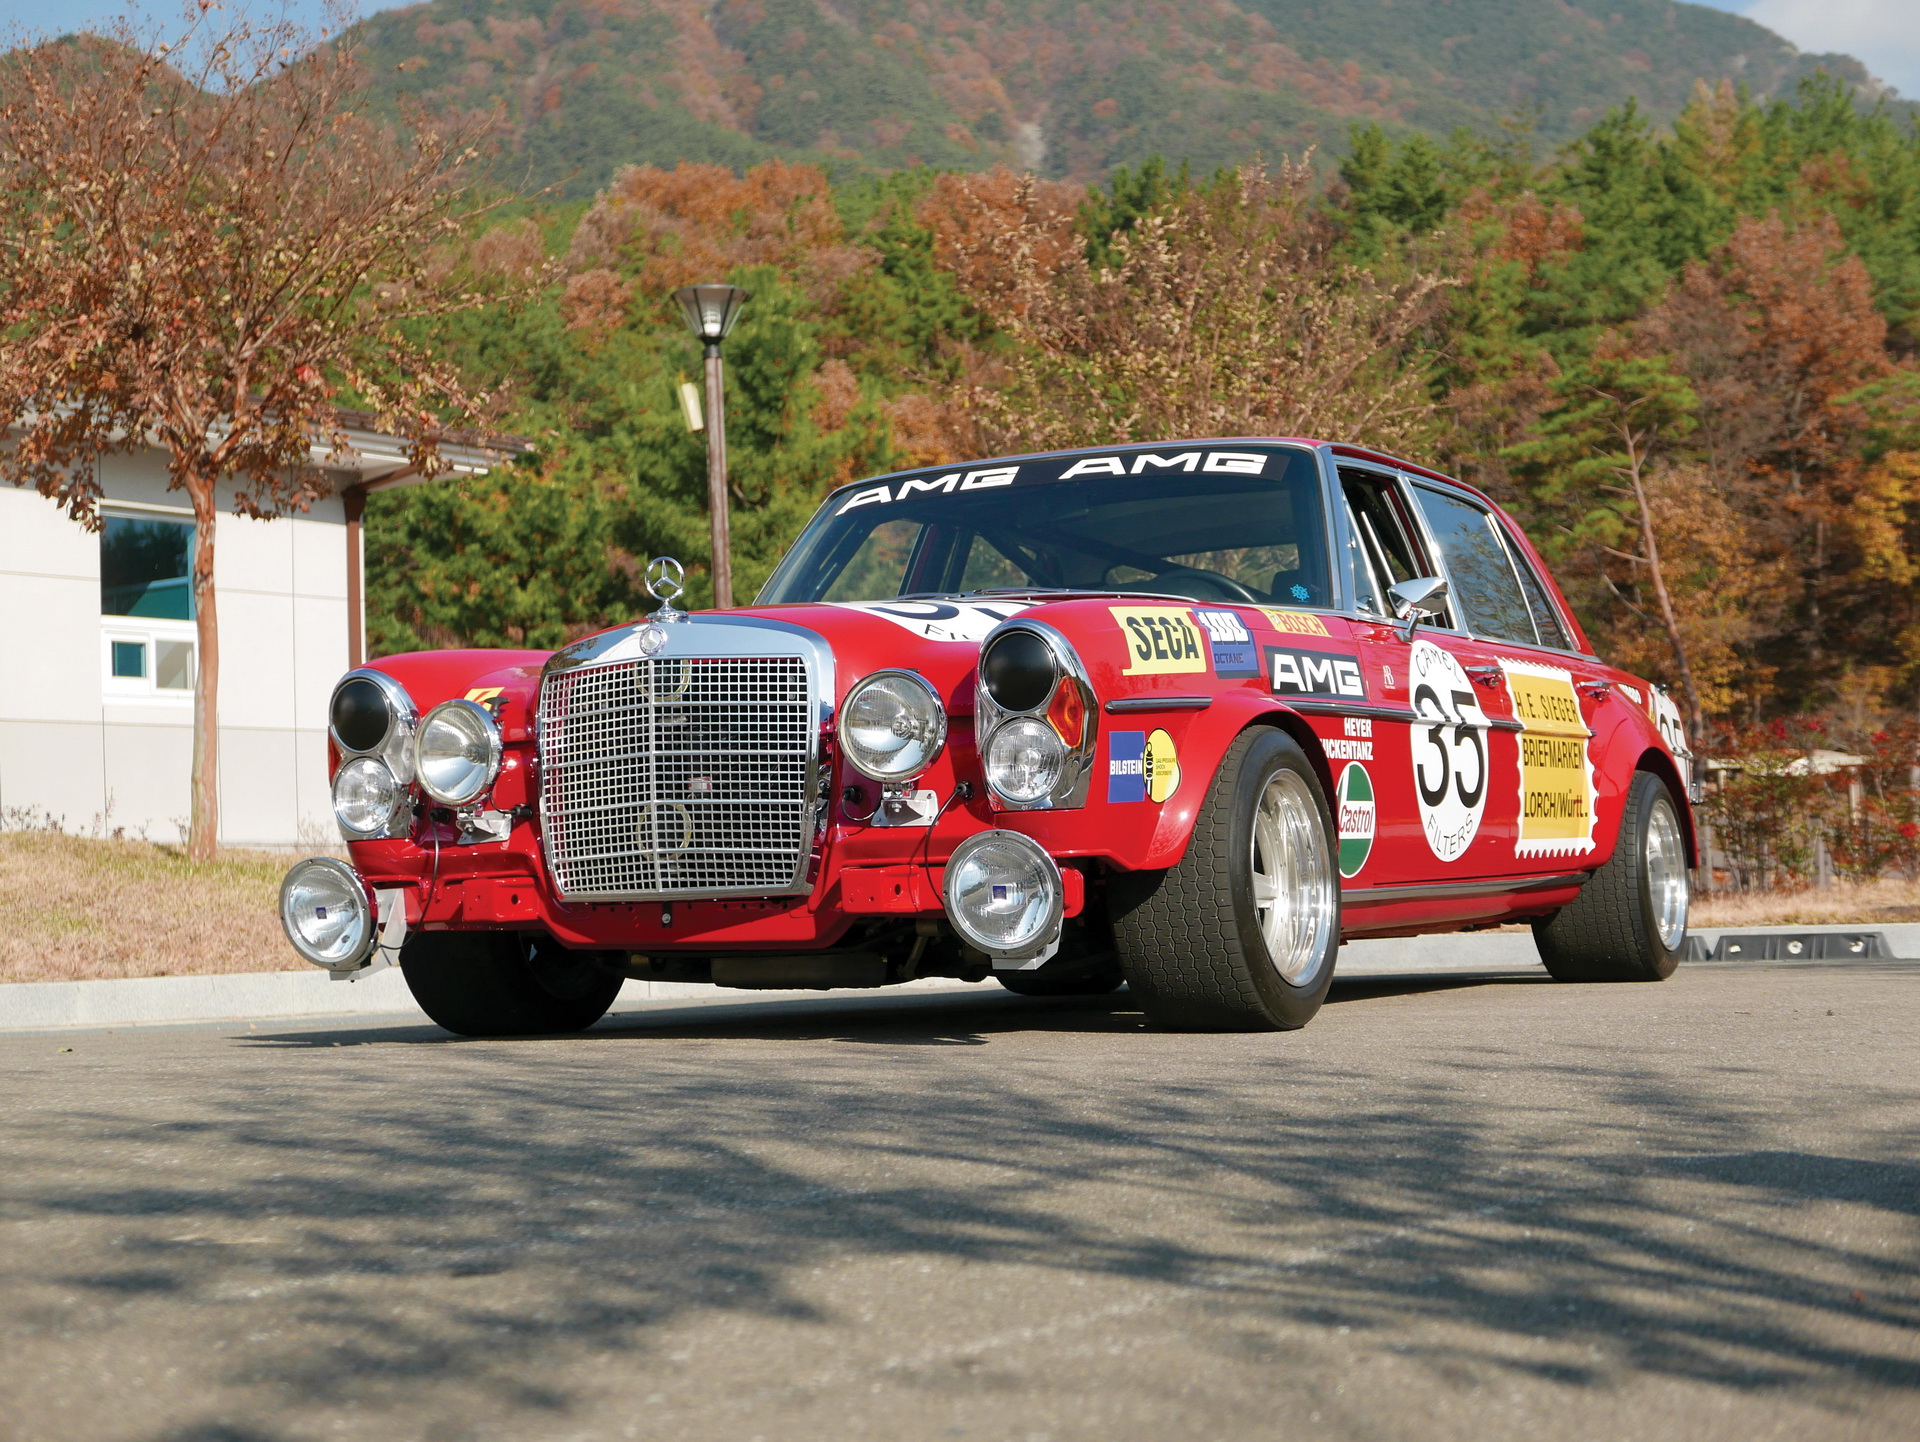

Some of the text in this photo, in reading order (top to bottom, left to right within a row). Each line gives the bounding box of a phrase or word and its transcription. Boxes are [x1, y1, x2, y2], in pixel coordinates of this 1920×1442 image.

[834, 452, 1268, 517] AMG AMG
[1126, 616, 1200, 661] SECA
[1197, 612, 1250, 645] 100
[1275, 613, 1328, 635] BOSCH
[1213, 652, 1245, 664] OCTANE
[1415, 647, 1462, 684] CAMEL
[1273, 653, 1364, 696] AMG
[1540, 694, 1581, 724] SIEGER
[1344, 717, 1372, 737] HEYER
[1414, 683, 1485, 809] 35
[1522, 738, 1585, 769] BRIEFMARKEN
[1109, 759, 1143, 775] BILSTEIN
[1338, 804, 1374, 833] Castrol
[1427, 813, 1474, 856] FILTERS
